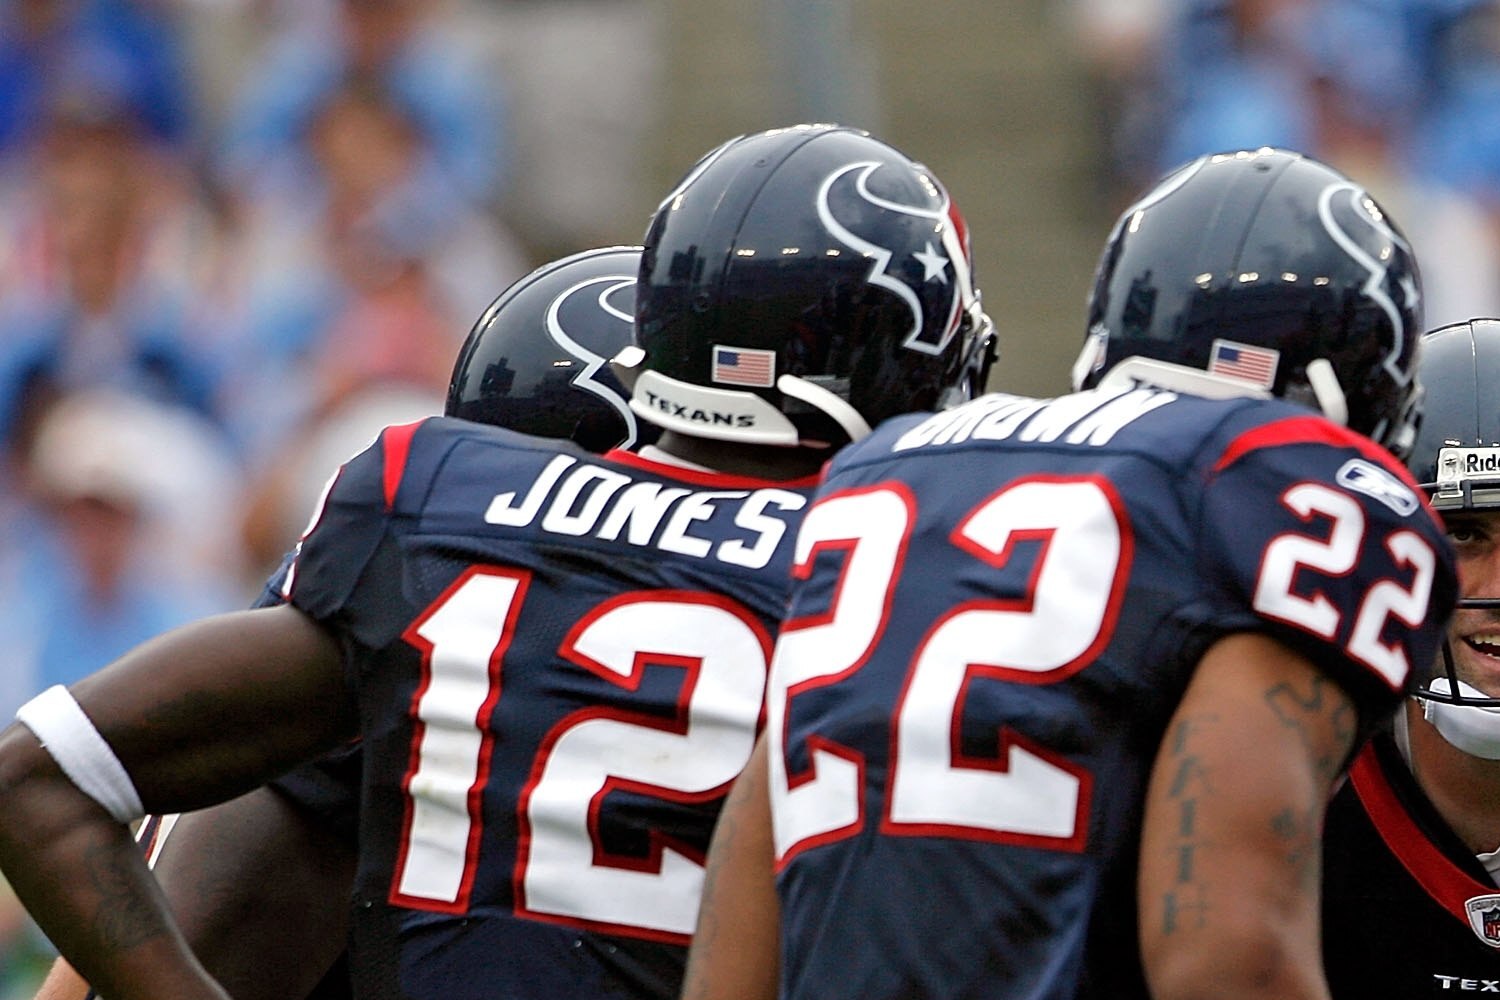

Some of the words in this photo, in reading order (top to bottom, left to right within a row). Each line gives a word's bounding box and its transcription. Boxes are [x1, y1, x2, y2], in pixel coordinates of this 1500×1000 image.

[645, 390, 755, 427] TEXANS
[892, 386, 1179, 453] BROWN
[484, 453, 807, 570] JONES
[1250, 478, 1438, 693] 22
[390, 565, 775, 943] 12
[770, 475, 1133, 870] 22
